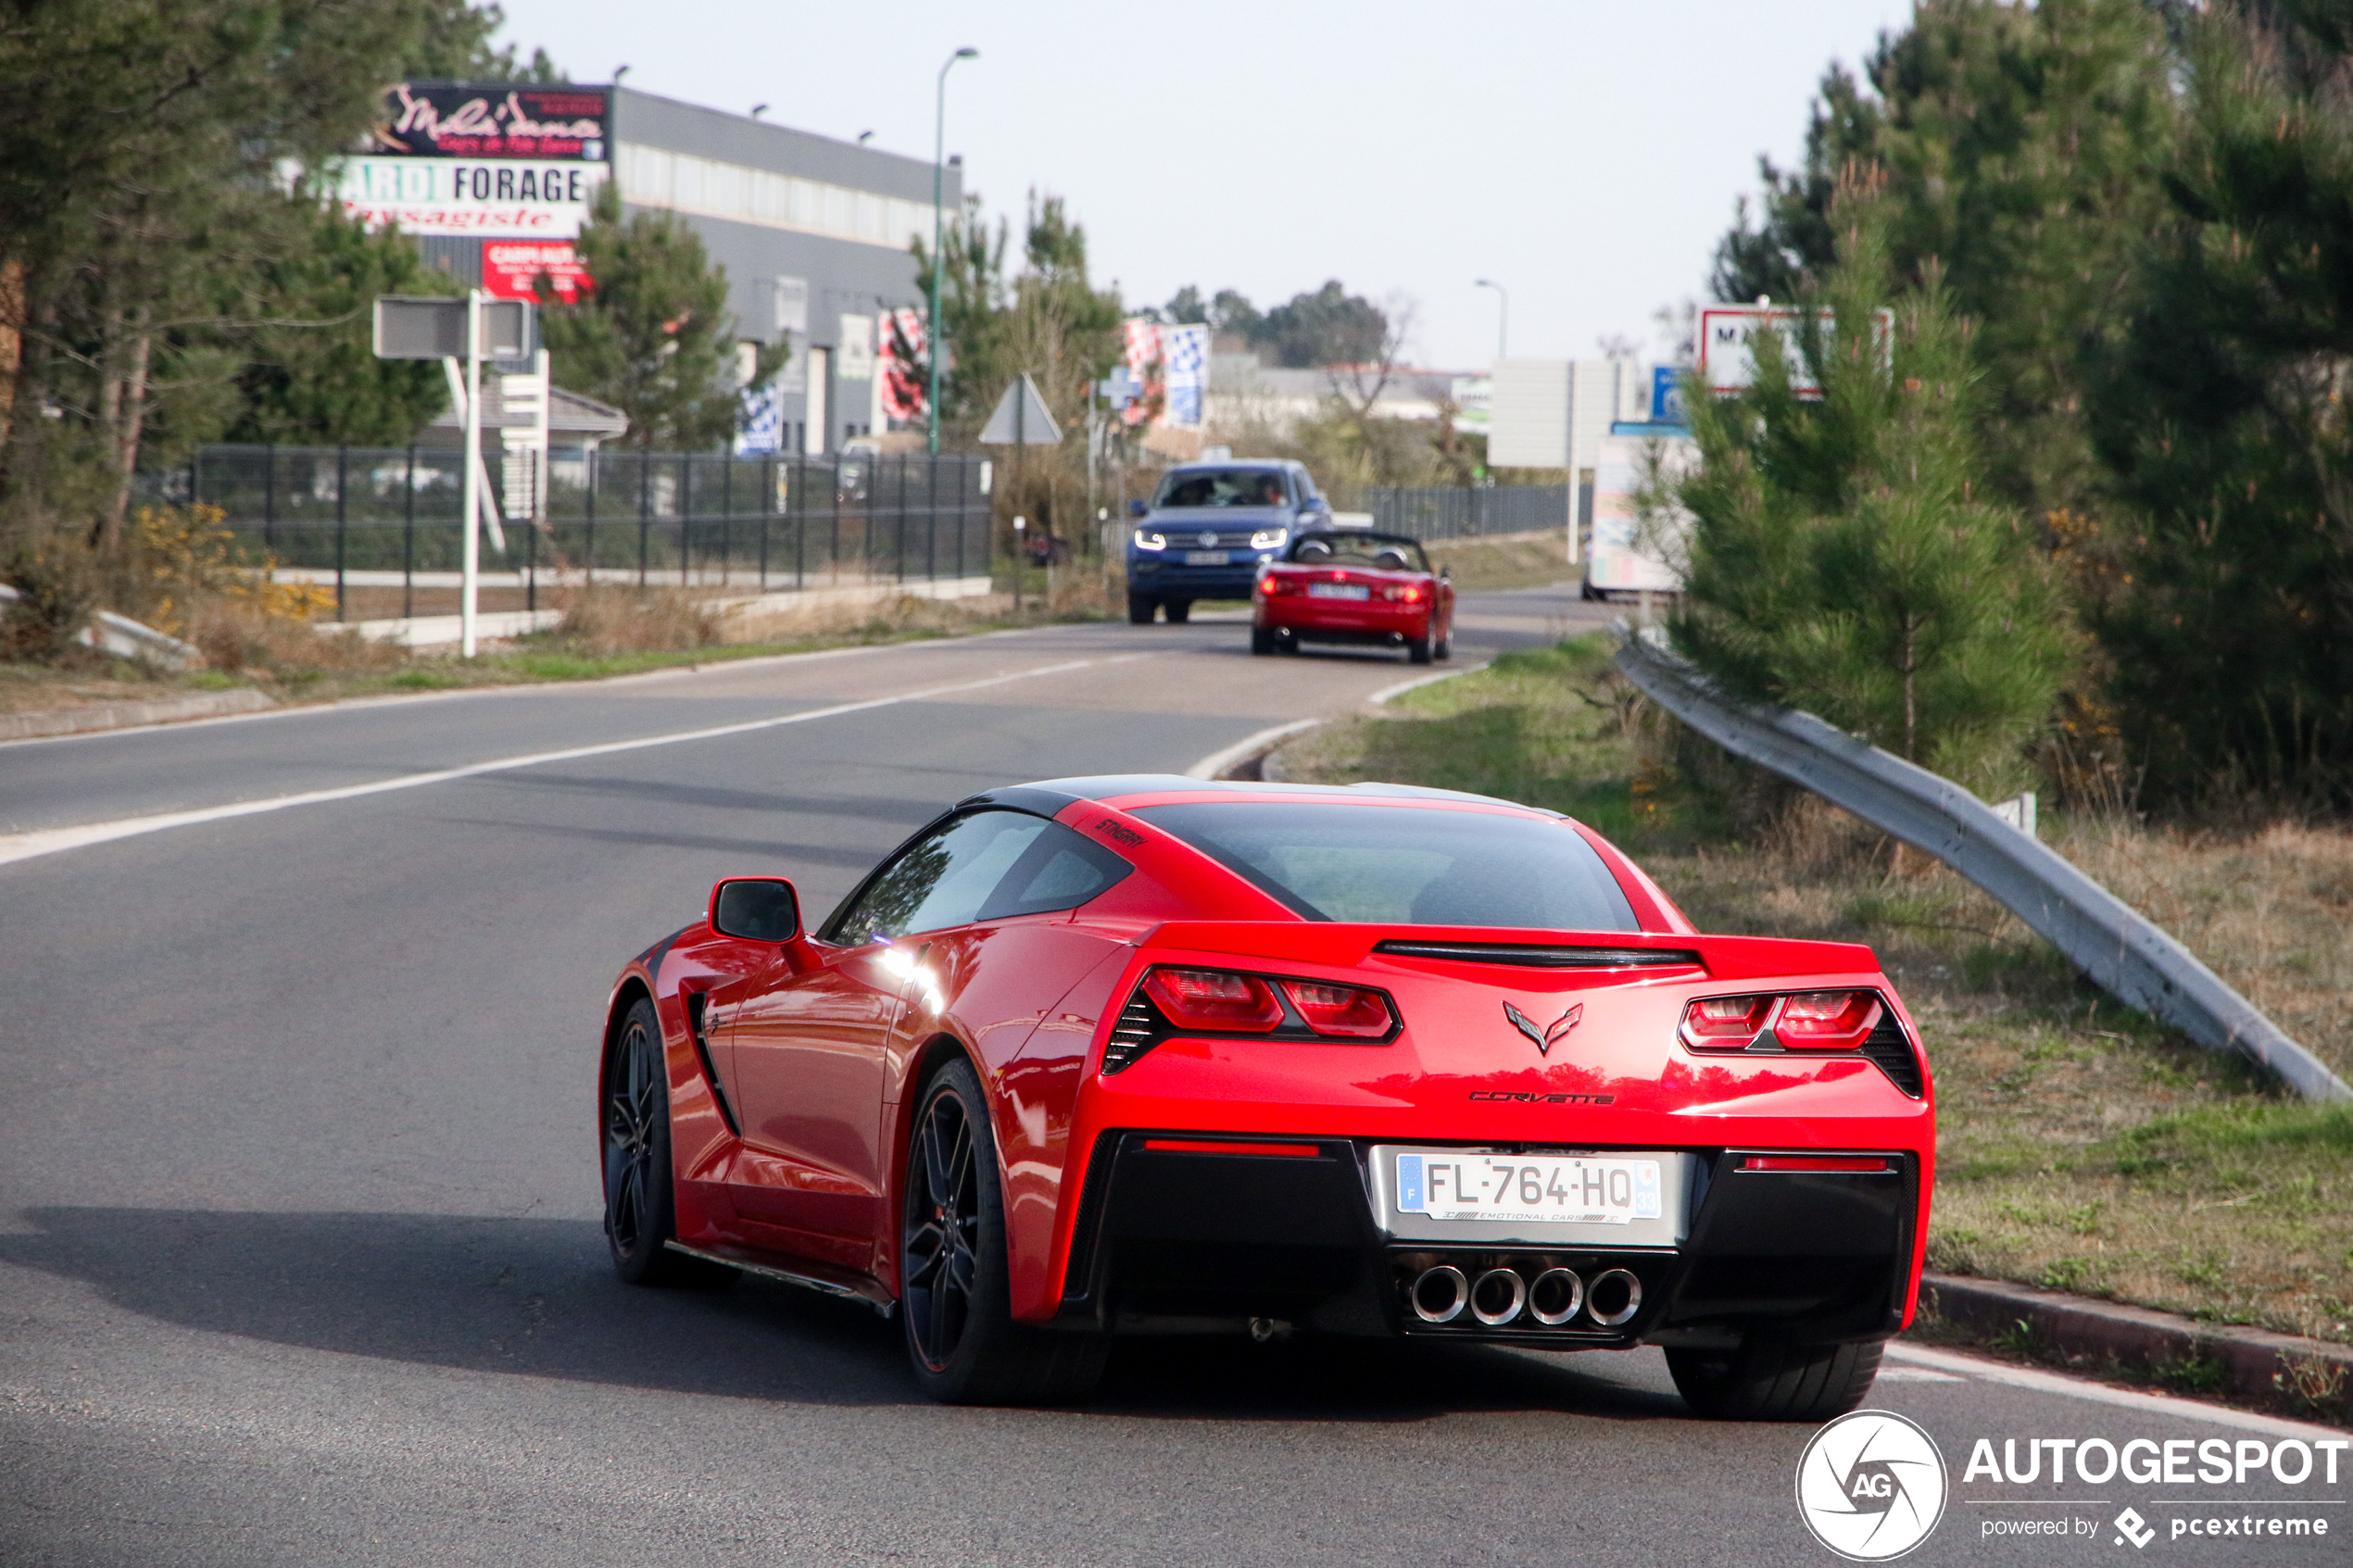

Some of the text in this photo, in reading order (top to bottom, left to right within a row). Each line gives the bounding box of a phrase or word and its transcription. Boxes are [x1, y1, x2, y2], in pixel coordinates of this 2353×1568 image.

[332, 164, 583, 201] ARDI FORAGE
[1095, 819, 1149, 848] STINGRAY
[1469, 1090, 1616, 1104] CORVETTE
[1407, 1163, 1656, 1211] F FL-764-HQ 33
[1479, 1212, 1583, 1223] EMOTIONAL CARS
